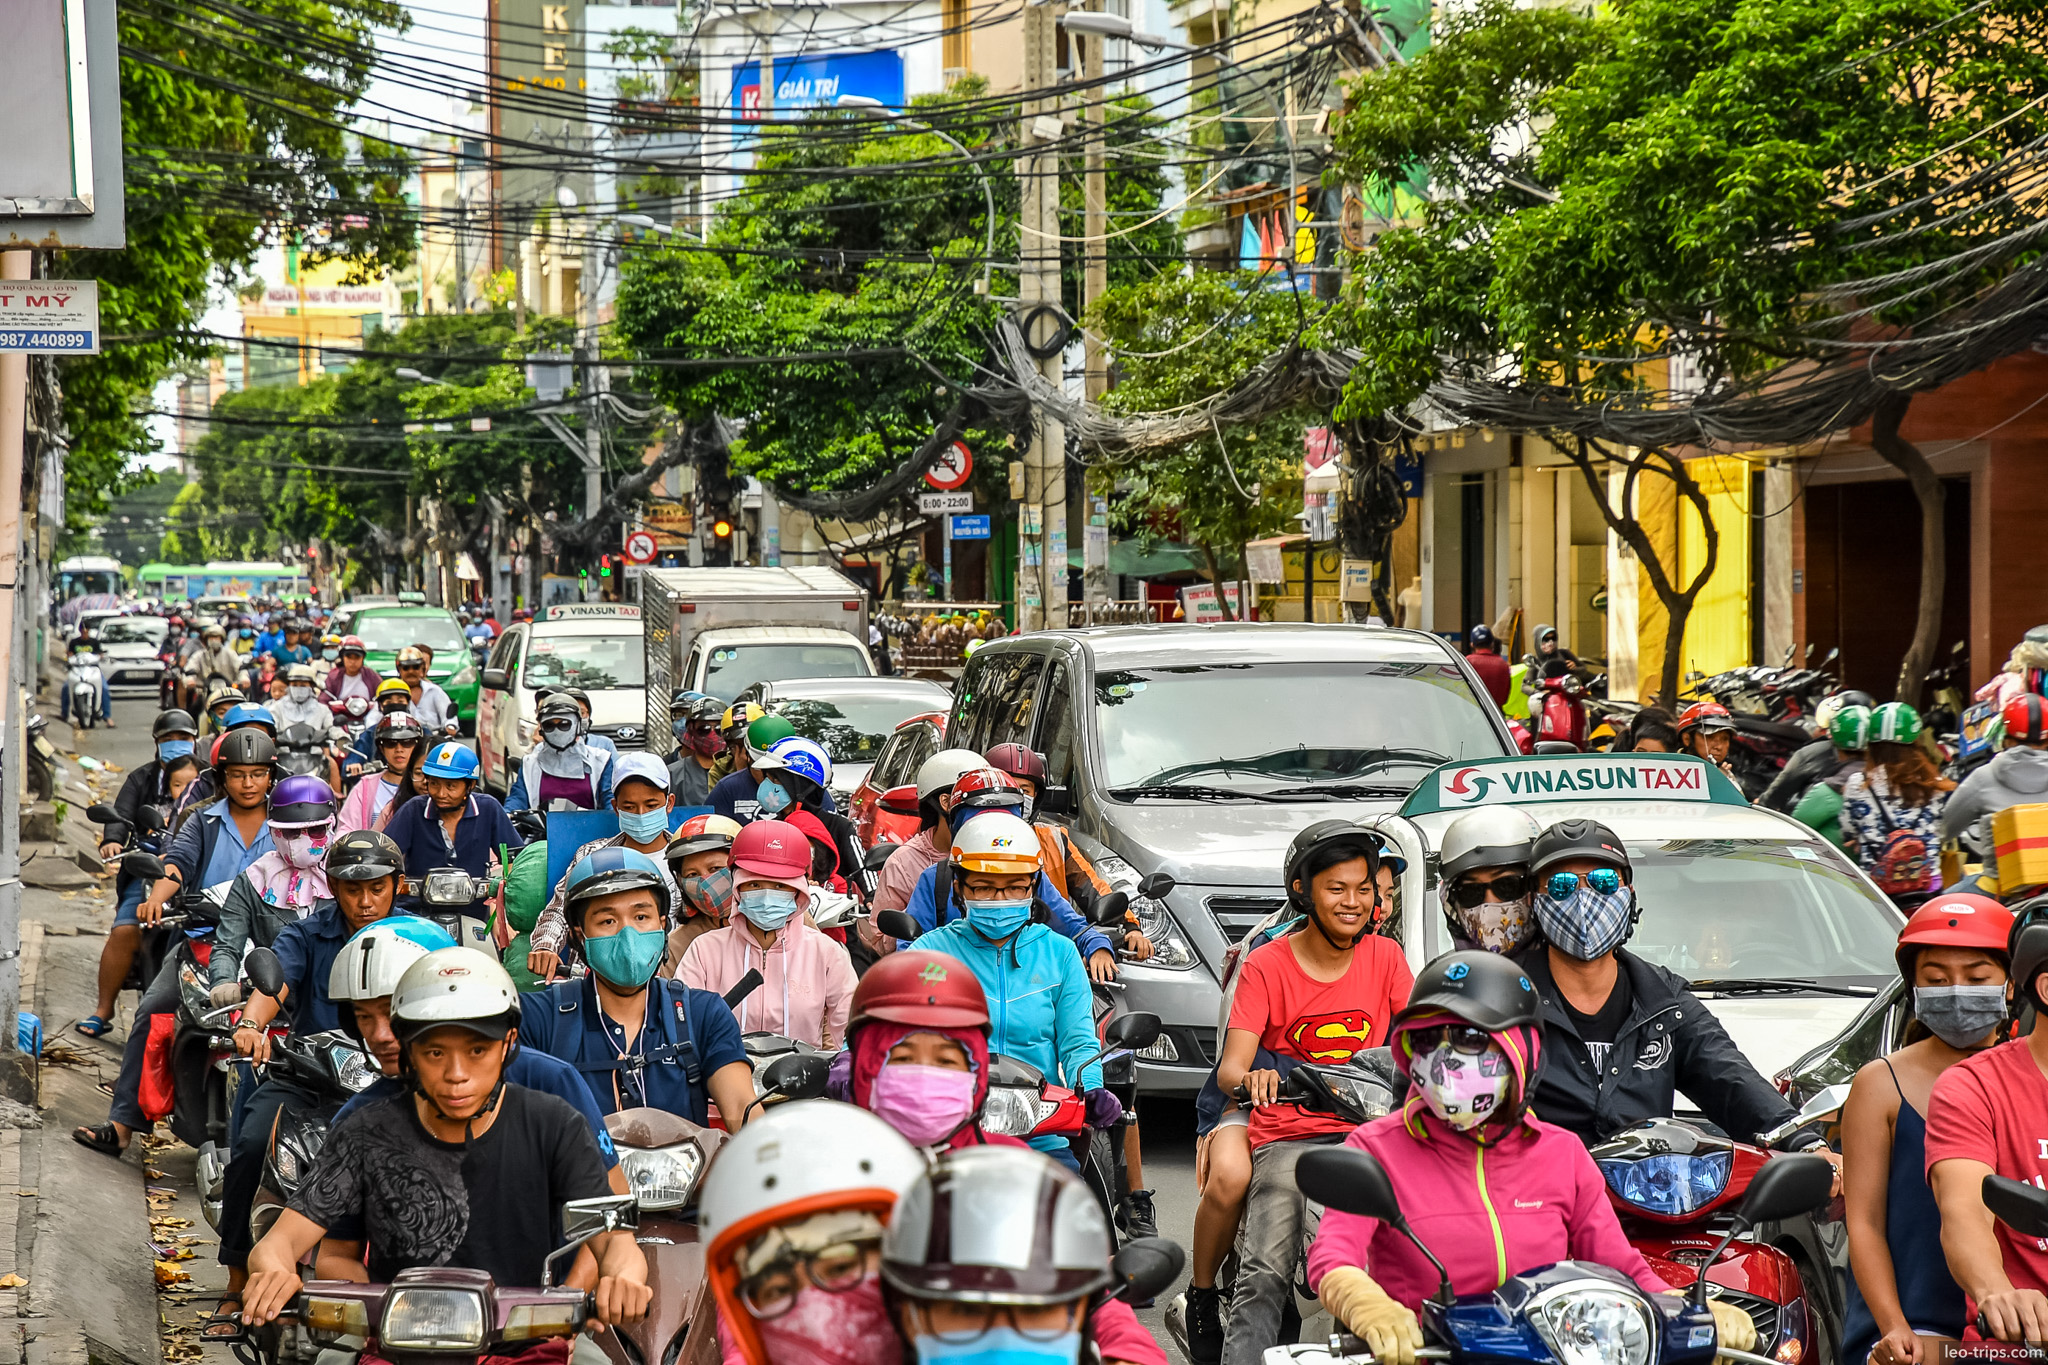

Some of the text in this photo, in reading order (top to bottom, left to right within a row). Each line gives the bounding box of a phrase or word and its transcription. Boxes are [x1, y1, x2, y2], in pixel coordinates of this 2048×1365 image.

[778, 74, 840, 99] GIẢI TRÍ
[16, 284, 45, 292] QUẢNG
[26, 293, 71, 308] MỸ
[923, 498, 941, 508] 6:00
[947, 497, 969, 507] 22:00
[570, 607, 640, 616] VINASUN TAXI
[1501, 767, 1700, 794] VINASUN TAXI
[1671, 1239, 1713, 1247] HONDA
